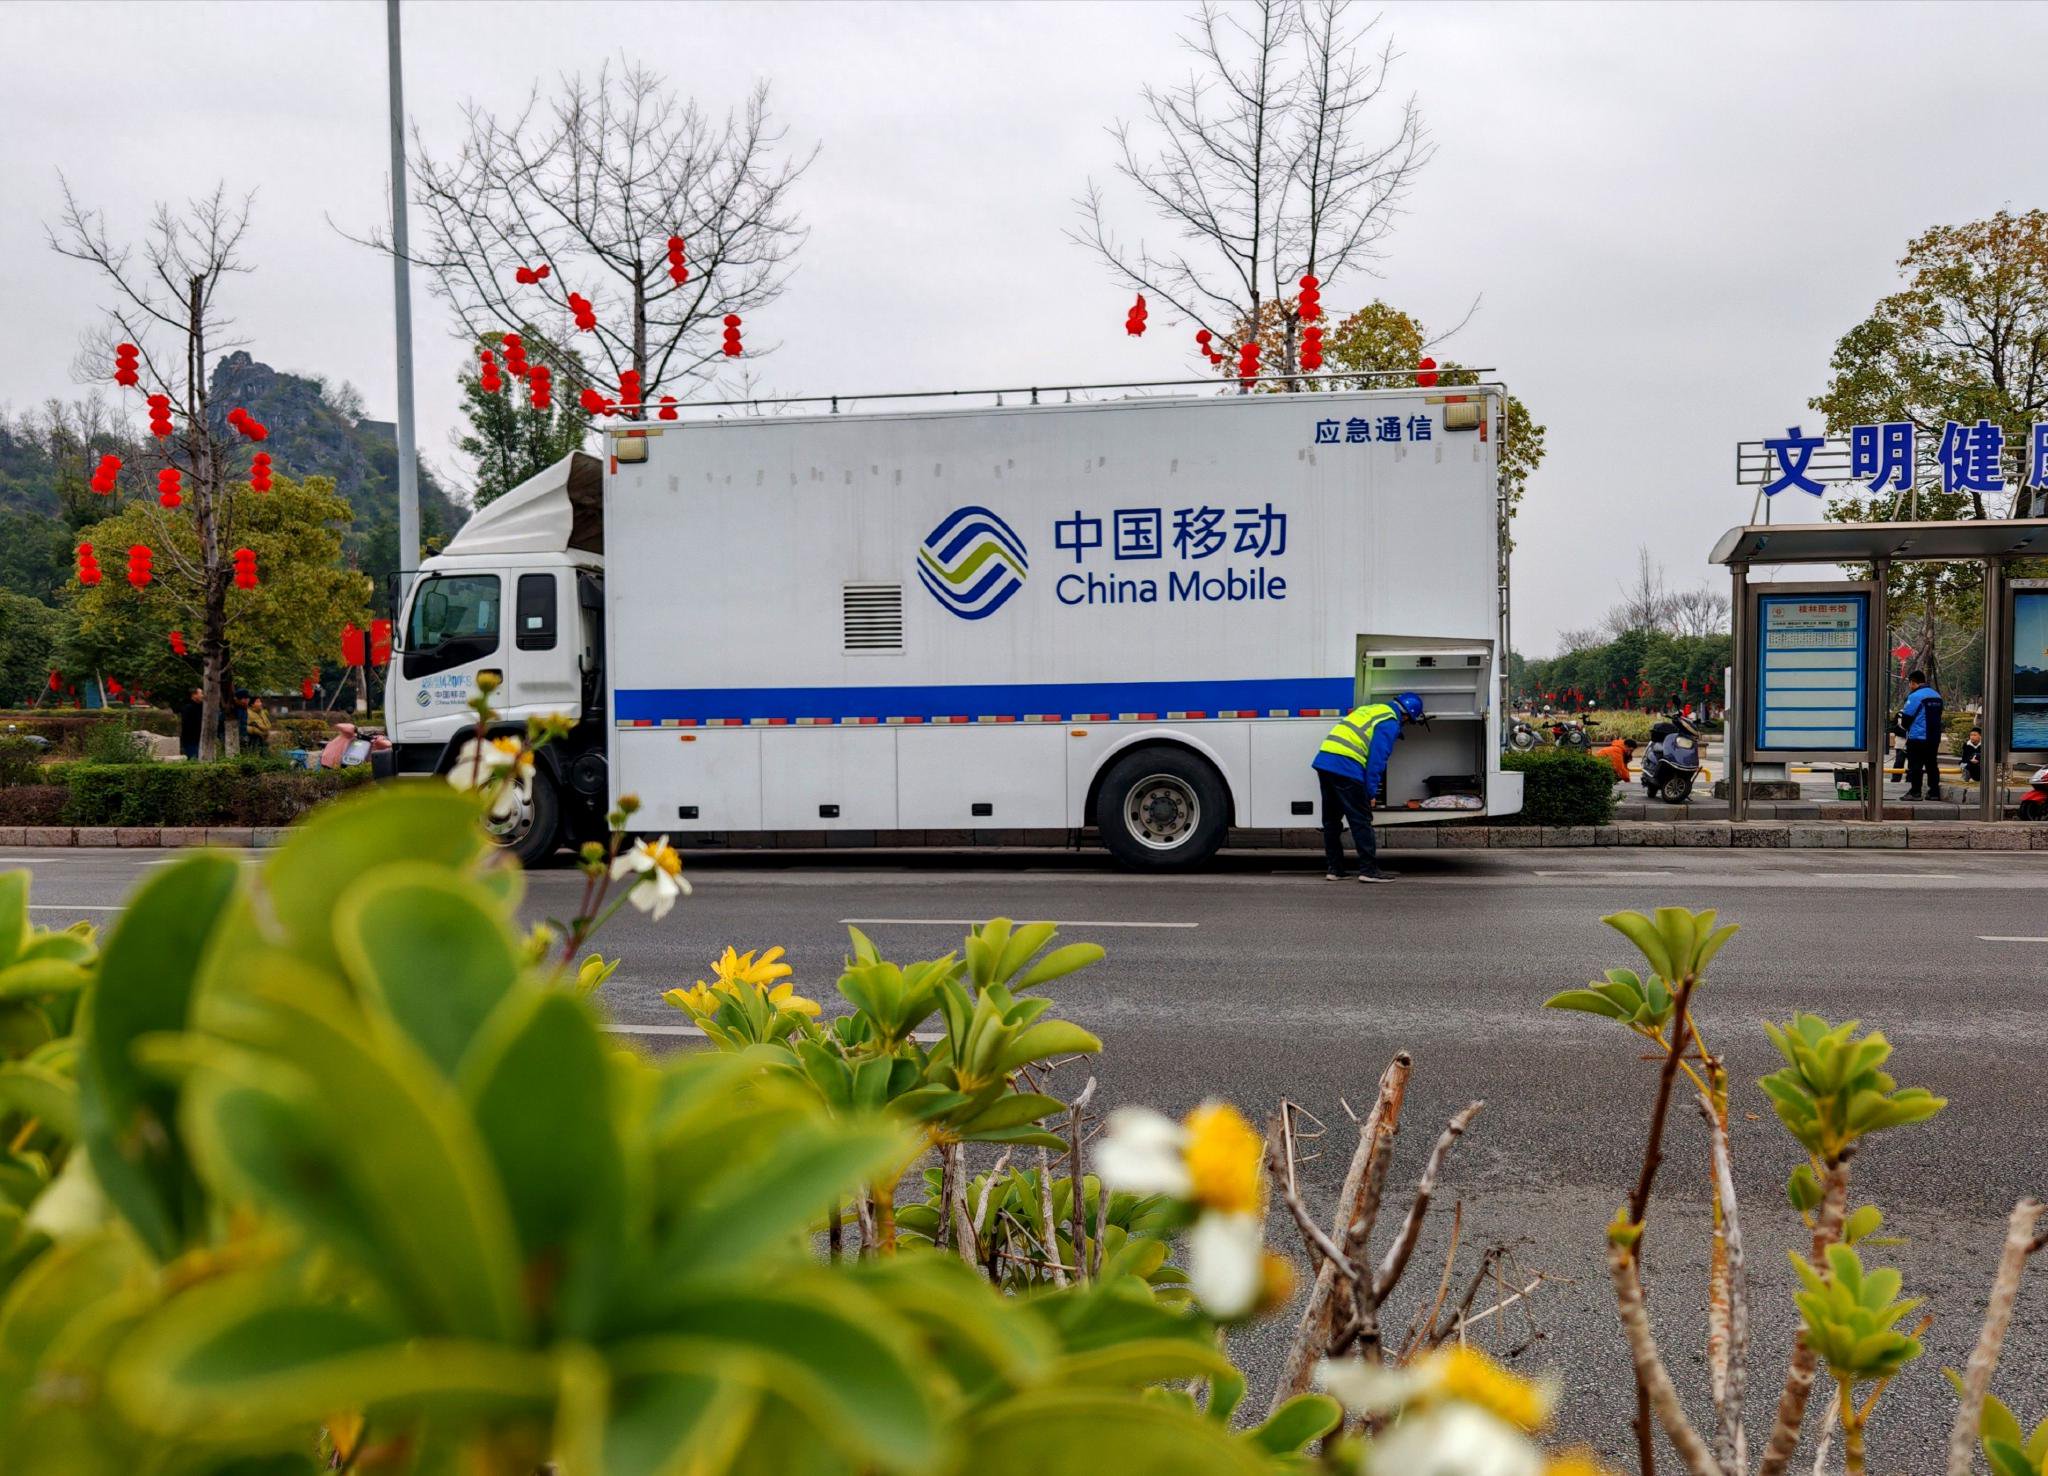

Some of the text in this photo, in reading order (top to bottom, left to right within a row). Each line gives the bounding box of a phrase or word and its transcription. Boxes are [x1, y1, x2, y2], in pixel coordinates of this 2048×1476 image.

[1315, 415, 1432, 443] 应急通信
[1055, 503, 1287, 563] 中国移动
[1056, 567, 1287, 605] China Mobile
